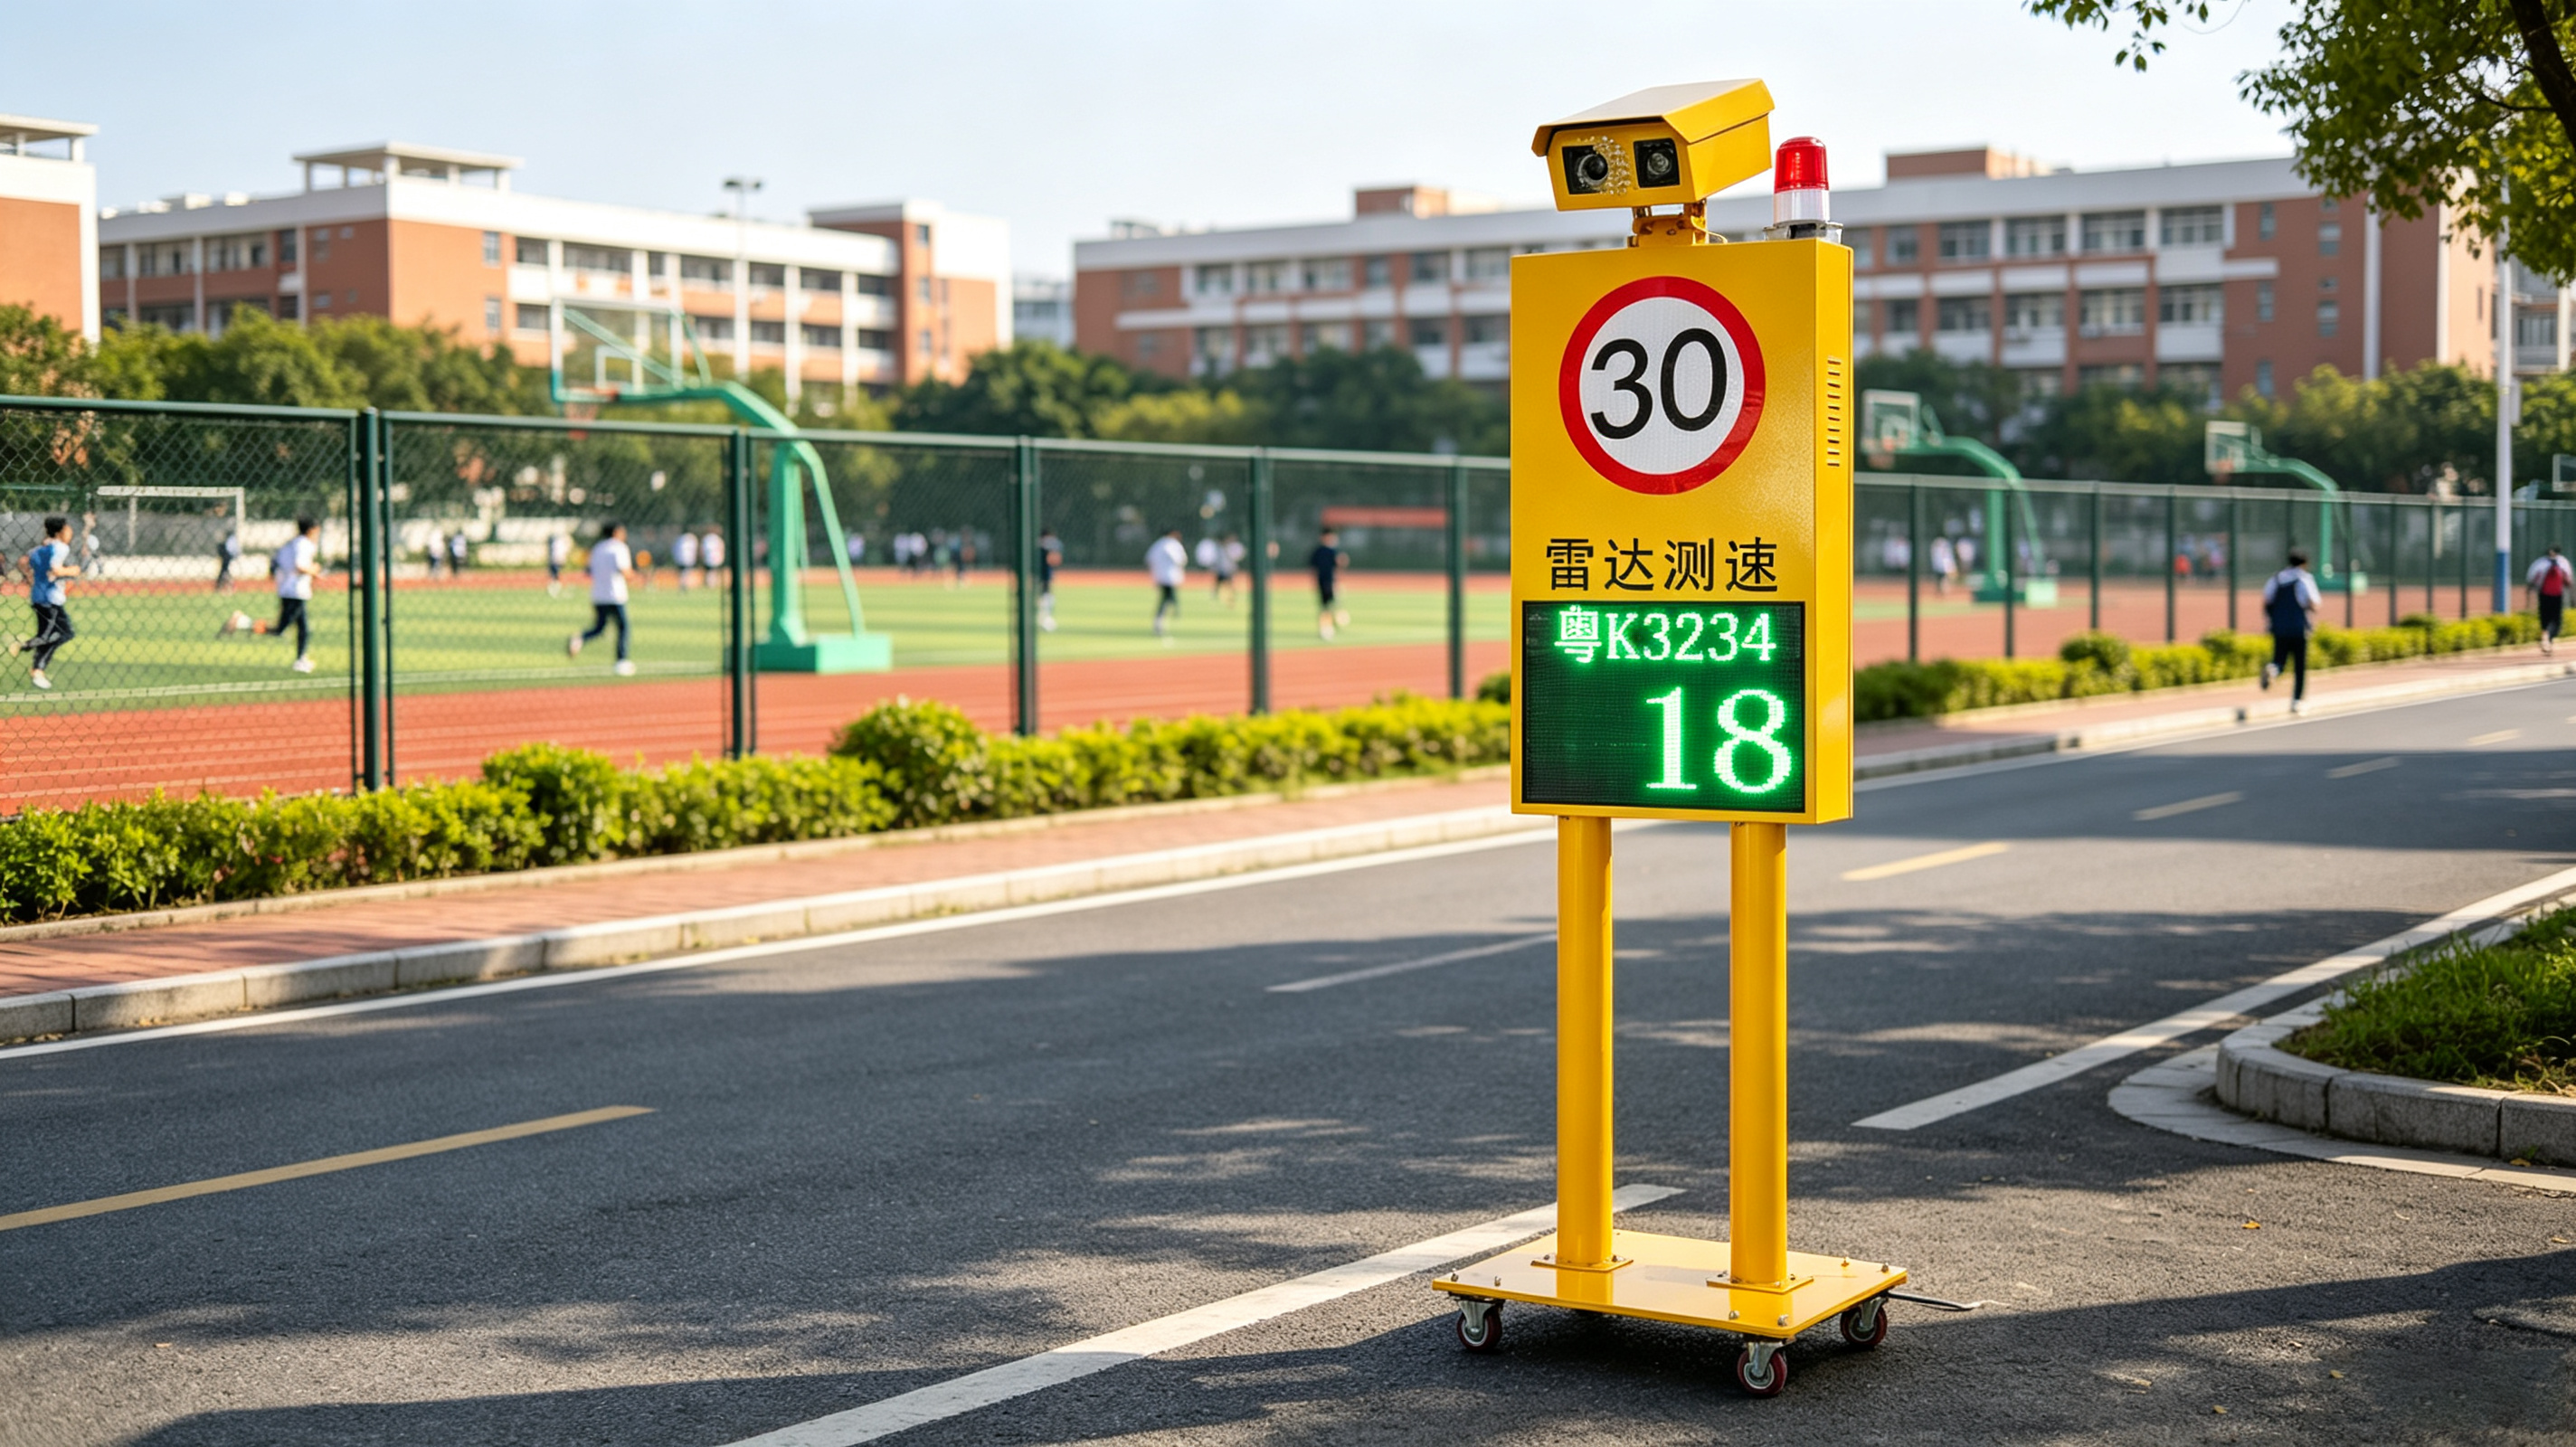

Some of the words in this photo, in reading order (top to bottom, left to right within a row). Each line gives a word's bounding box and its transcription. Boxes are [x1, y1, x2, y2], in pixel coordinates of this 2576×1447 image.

[1590, 327, 1728, 440] 30
[1546, 537, 1777, 592] 雷达测速
[1554, 605, 1776, 663] 粤K3234
[1646, 686, 1792, 793] 18
